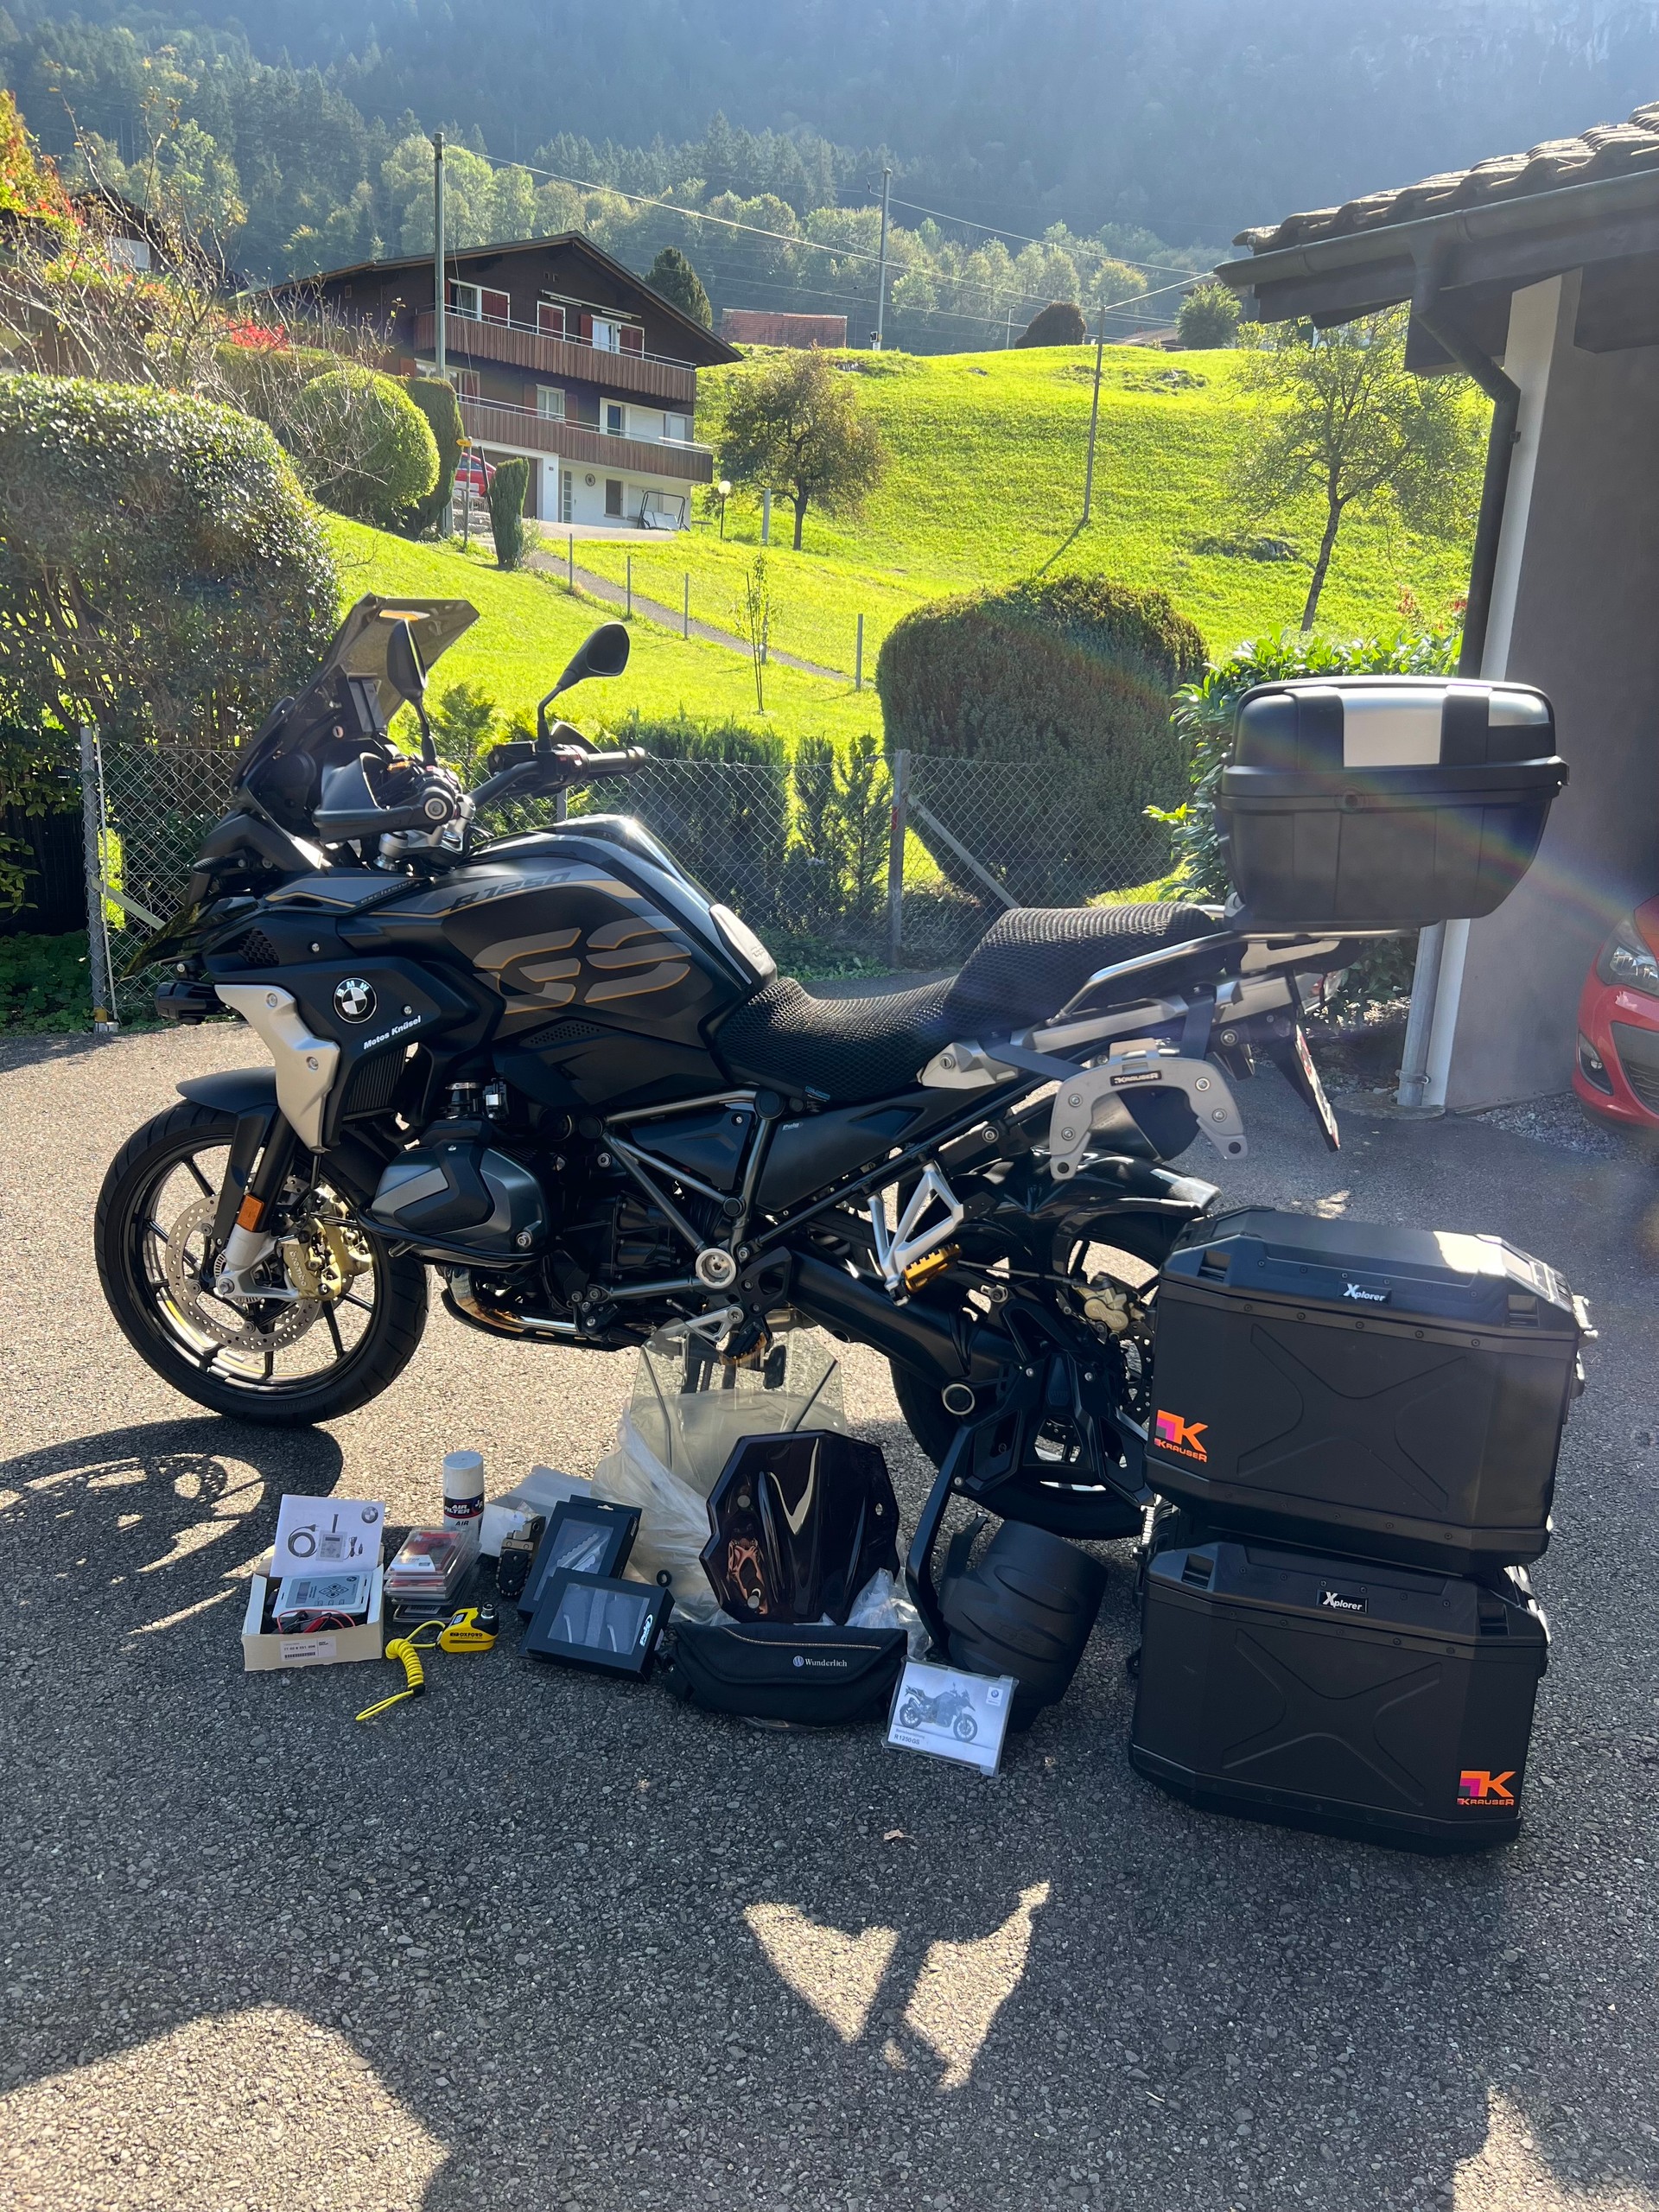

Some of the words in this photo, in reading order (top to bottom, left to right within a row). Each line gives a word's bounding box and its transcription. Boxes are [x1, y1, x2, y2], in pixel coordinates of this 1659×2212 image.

[359, 880, 415, 904] exclusive
[472, 915, 691, 1014] GS
[335, 980, 370, 998] BMW
[363, 1032, 390, 1050] Motos
[391, 1015, 422, 1036] Knüsel
[289, 1250, 307, 1287] brembo
[1343, 1283, 1386, 1301] Xplorer
[1158, 1438, 1207, 1463] KRAUSER
[1322, 1591, 1363, 1611] Xplorer
[804, 1658, 848, 1667] Wunderlich
